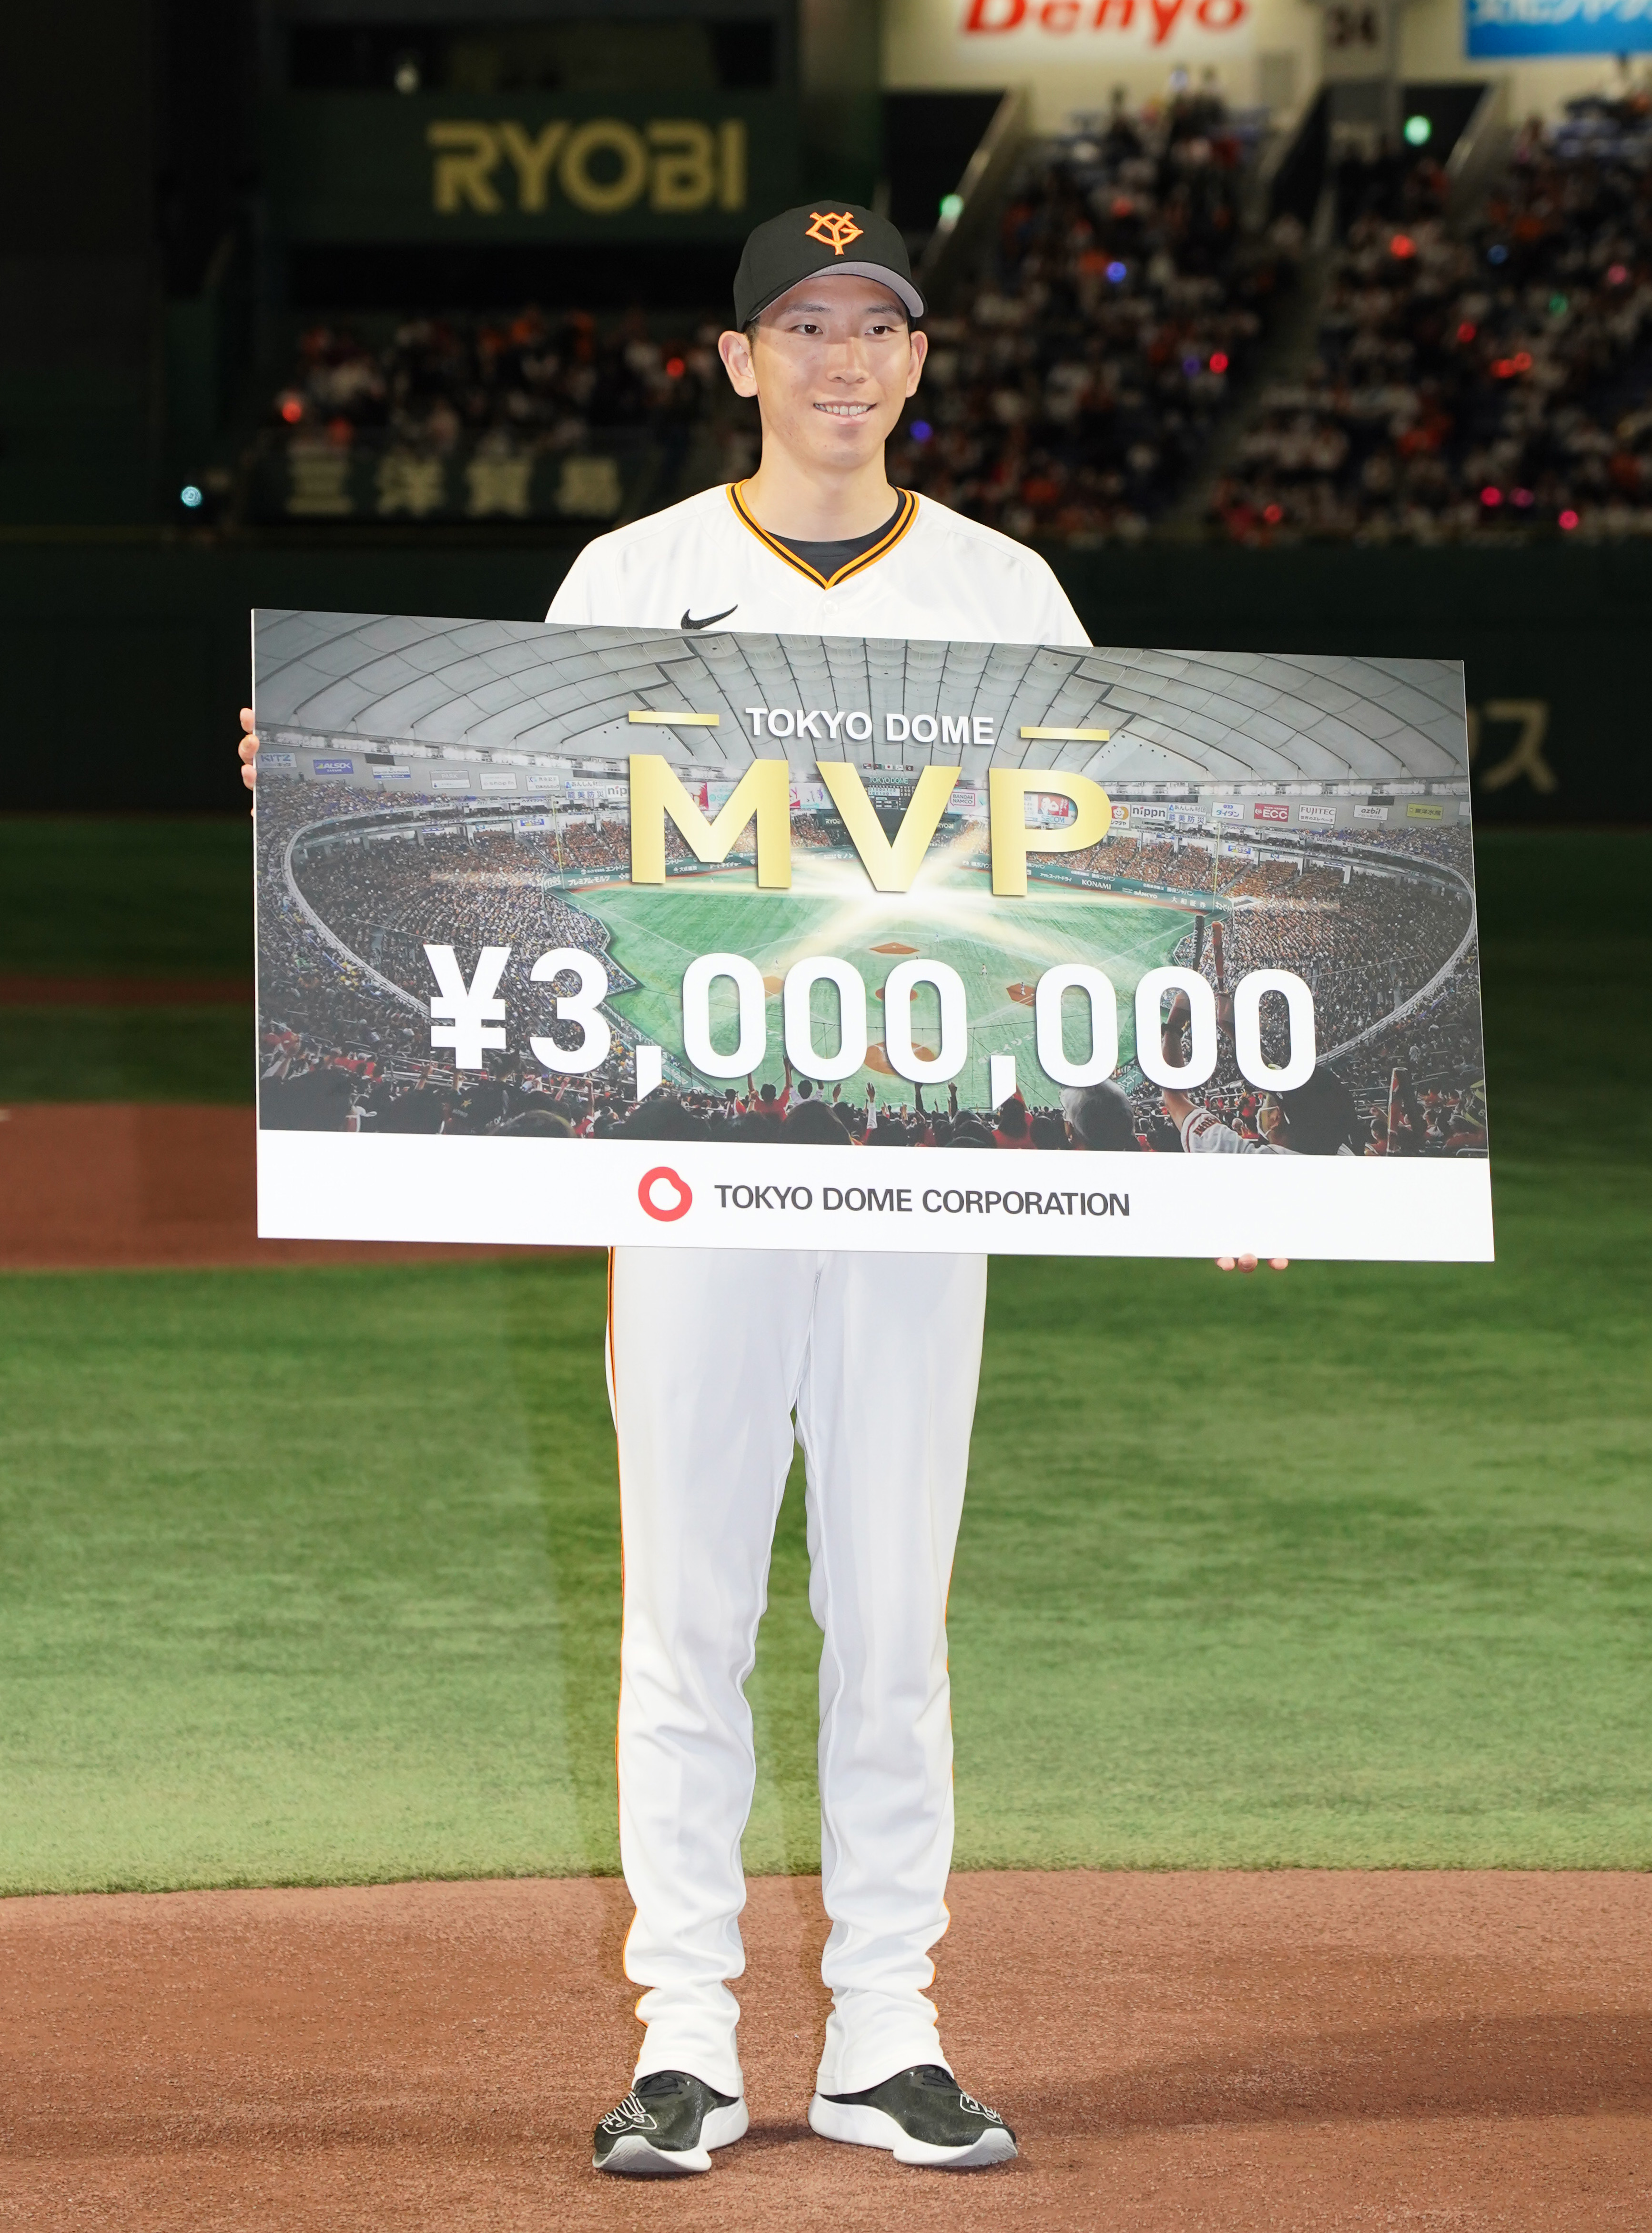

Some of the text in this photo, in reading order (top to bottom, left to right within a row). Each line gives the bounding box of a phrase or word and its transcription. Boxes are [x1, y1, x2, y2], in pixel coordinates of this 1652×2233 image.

[429, 120, 747, 214] RYOBI
[745, 707, 995, 744] TOKYO DOME
[1467, 699, 1559, 794] ス
[608, 785, 629, 796] nip
[1133, 806, 1166, 818] nippn
[1263, 809, 1288, 819] ECC
[1301, 806, 1335, 816] FUJITEC
[629, 754, 1113, 896] MVP
[1169, 814, 1205, 824] 能美防災
[1082, 879, 1112, 890] KONAMI
[1134, 890, 1158, 899] SANKYO
[424, 945, 1316, 1111] ¥3,000,000
[715, 1185, 1129, 1216] TOKYO DOME CORPORATION
